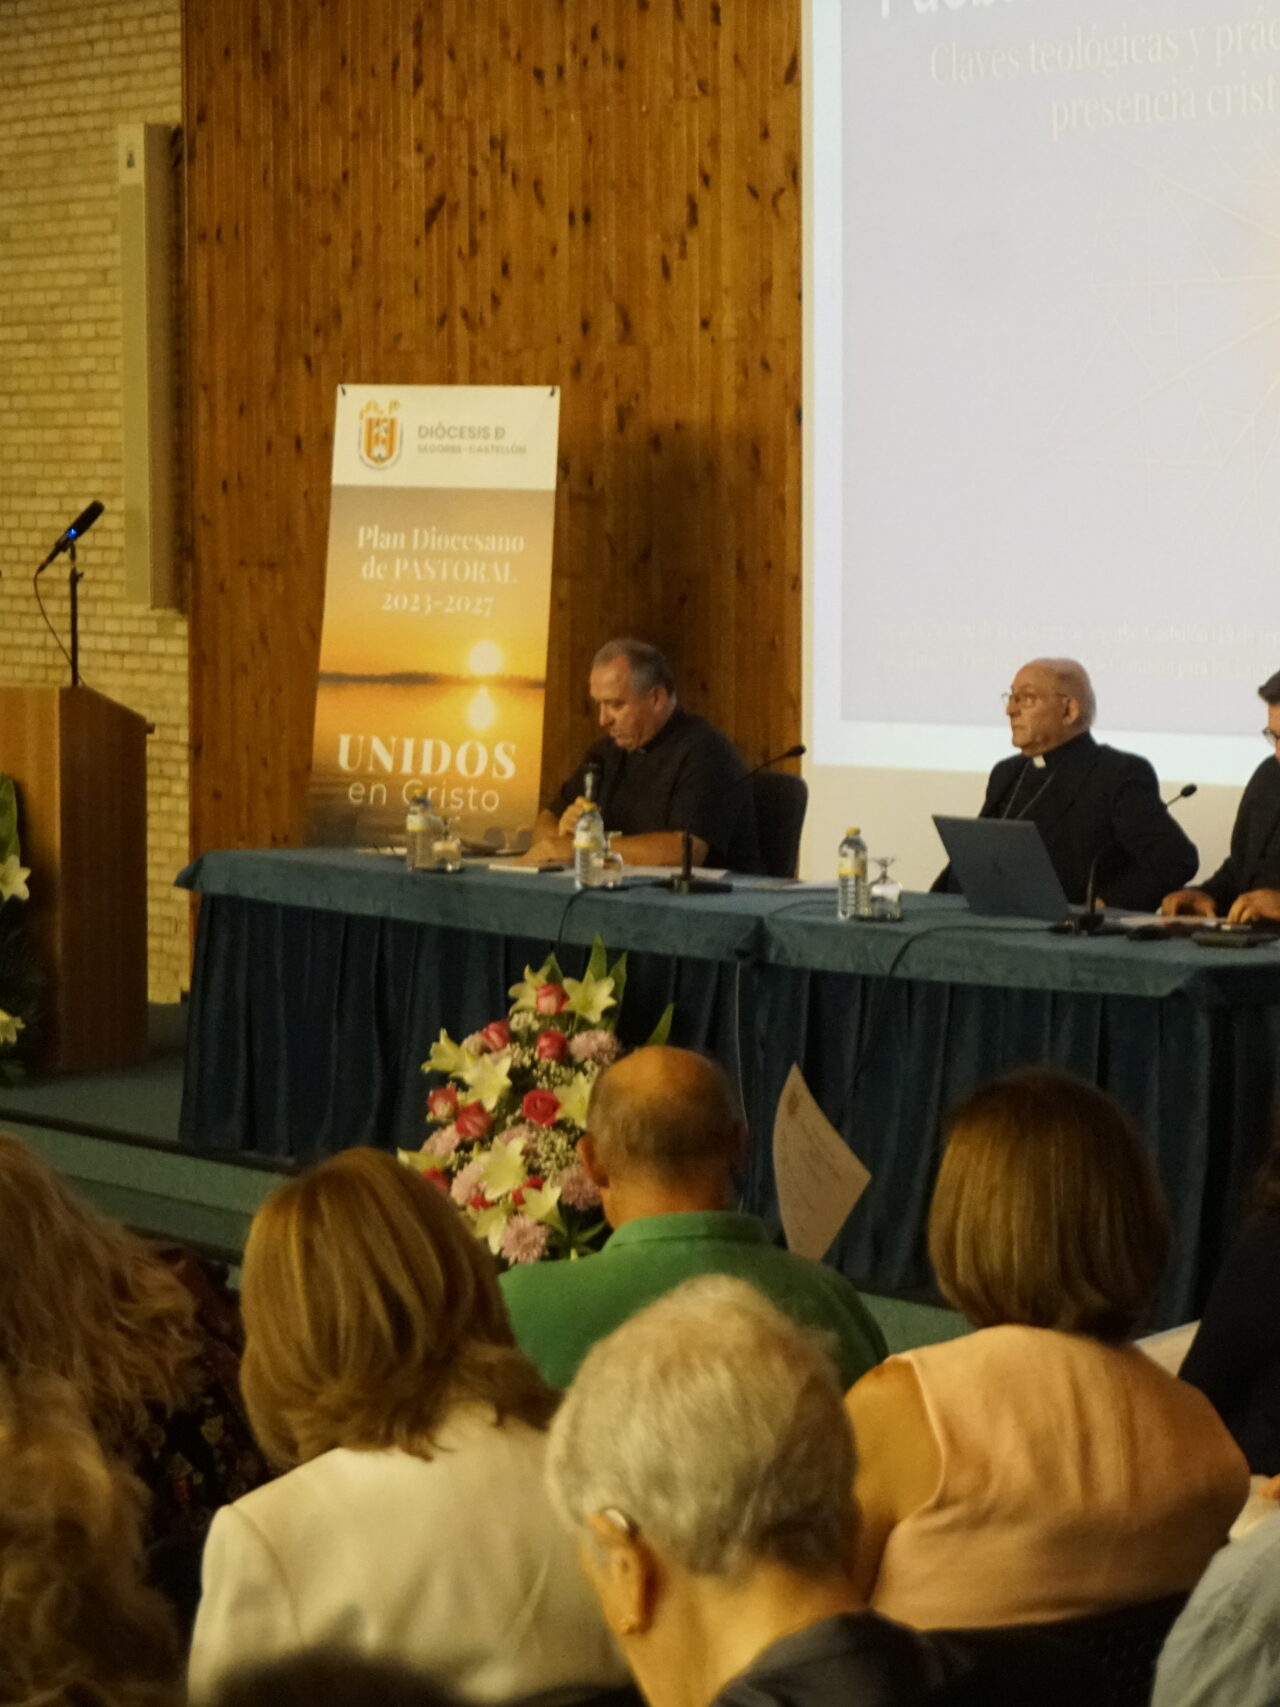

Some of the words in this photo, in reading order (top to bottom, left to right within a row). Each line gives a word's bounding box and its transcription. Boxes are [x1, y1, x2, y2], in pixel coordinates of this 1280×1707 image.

[930, 41, 1019, 84] Claves
[1028, 23, 1179, 79] teológicas
[1188, 26, 1205, 71] y
[1050, 77, 1197, 143] presencia
[417, 421, 491, 440] DIÓCESIS
[357, 524, 406, 551] Plan
[412, 525, 525, 554] Diocesano
[361, 555, 388, 580] de
[394, 557, 517, 584] PASTORAL
[381, 592, 494, 617] 2023-2027
[338, 733, 517, 781] UNIDOS
[348, 782, 387, 806] en
[402, 779, 500, 813] Cristo
